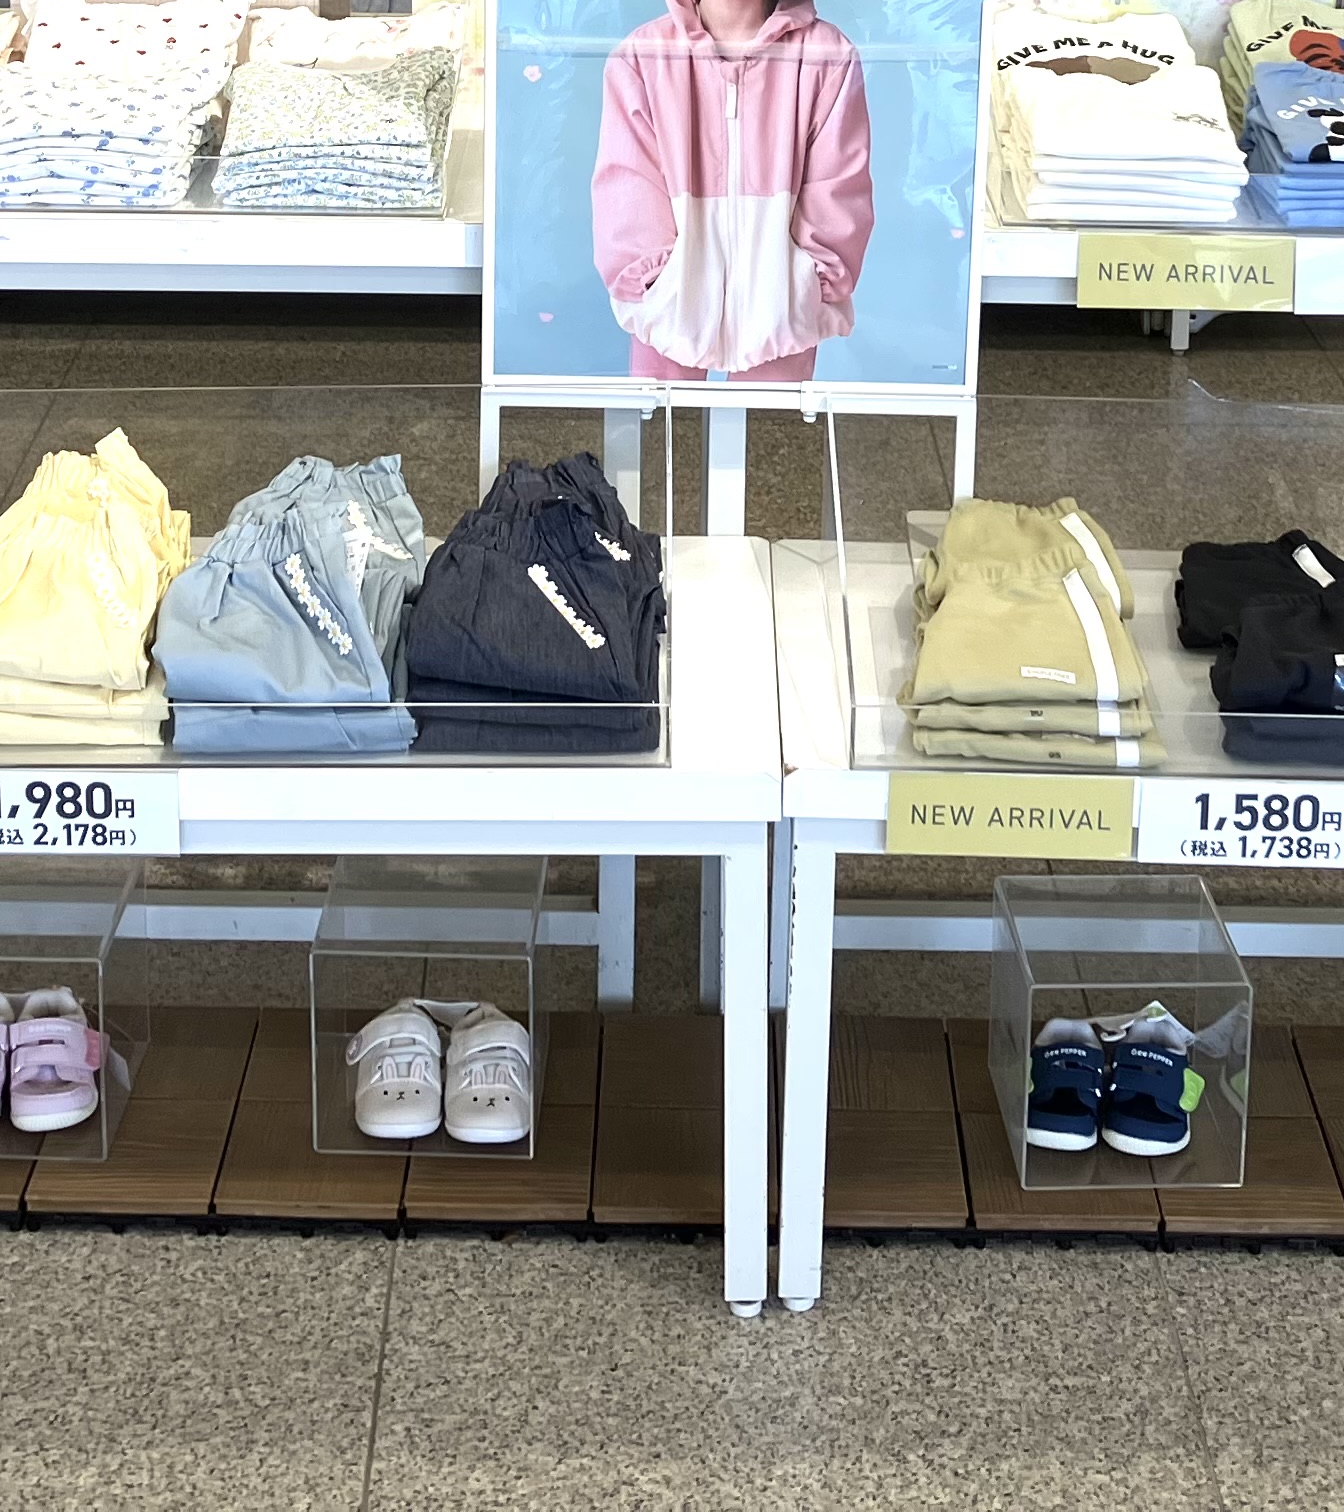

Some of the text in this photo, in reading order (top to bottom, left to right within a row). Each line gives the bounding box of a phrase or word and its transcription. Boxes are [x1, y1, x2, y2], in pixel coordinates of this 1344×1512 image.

[1246, 22, 1294, 53] GIVE
[997, 44, 1048, 71] GIVE
[1053, 37, 1091, 50] ME
[1121, 39, 1175, 67] HUG
[1276, 96, 1325, 121] GIVE
[1099, 262, 1274, 285] NEW ARRIVAL
[911, 804, 1111, 832] NEW ARRIVAL
[1194, 793, 1342, 833] 1,580円
